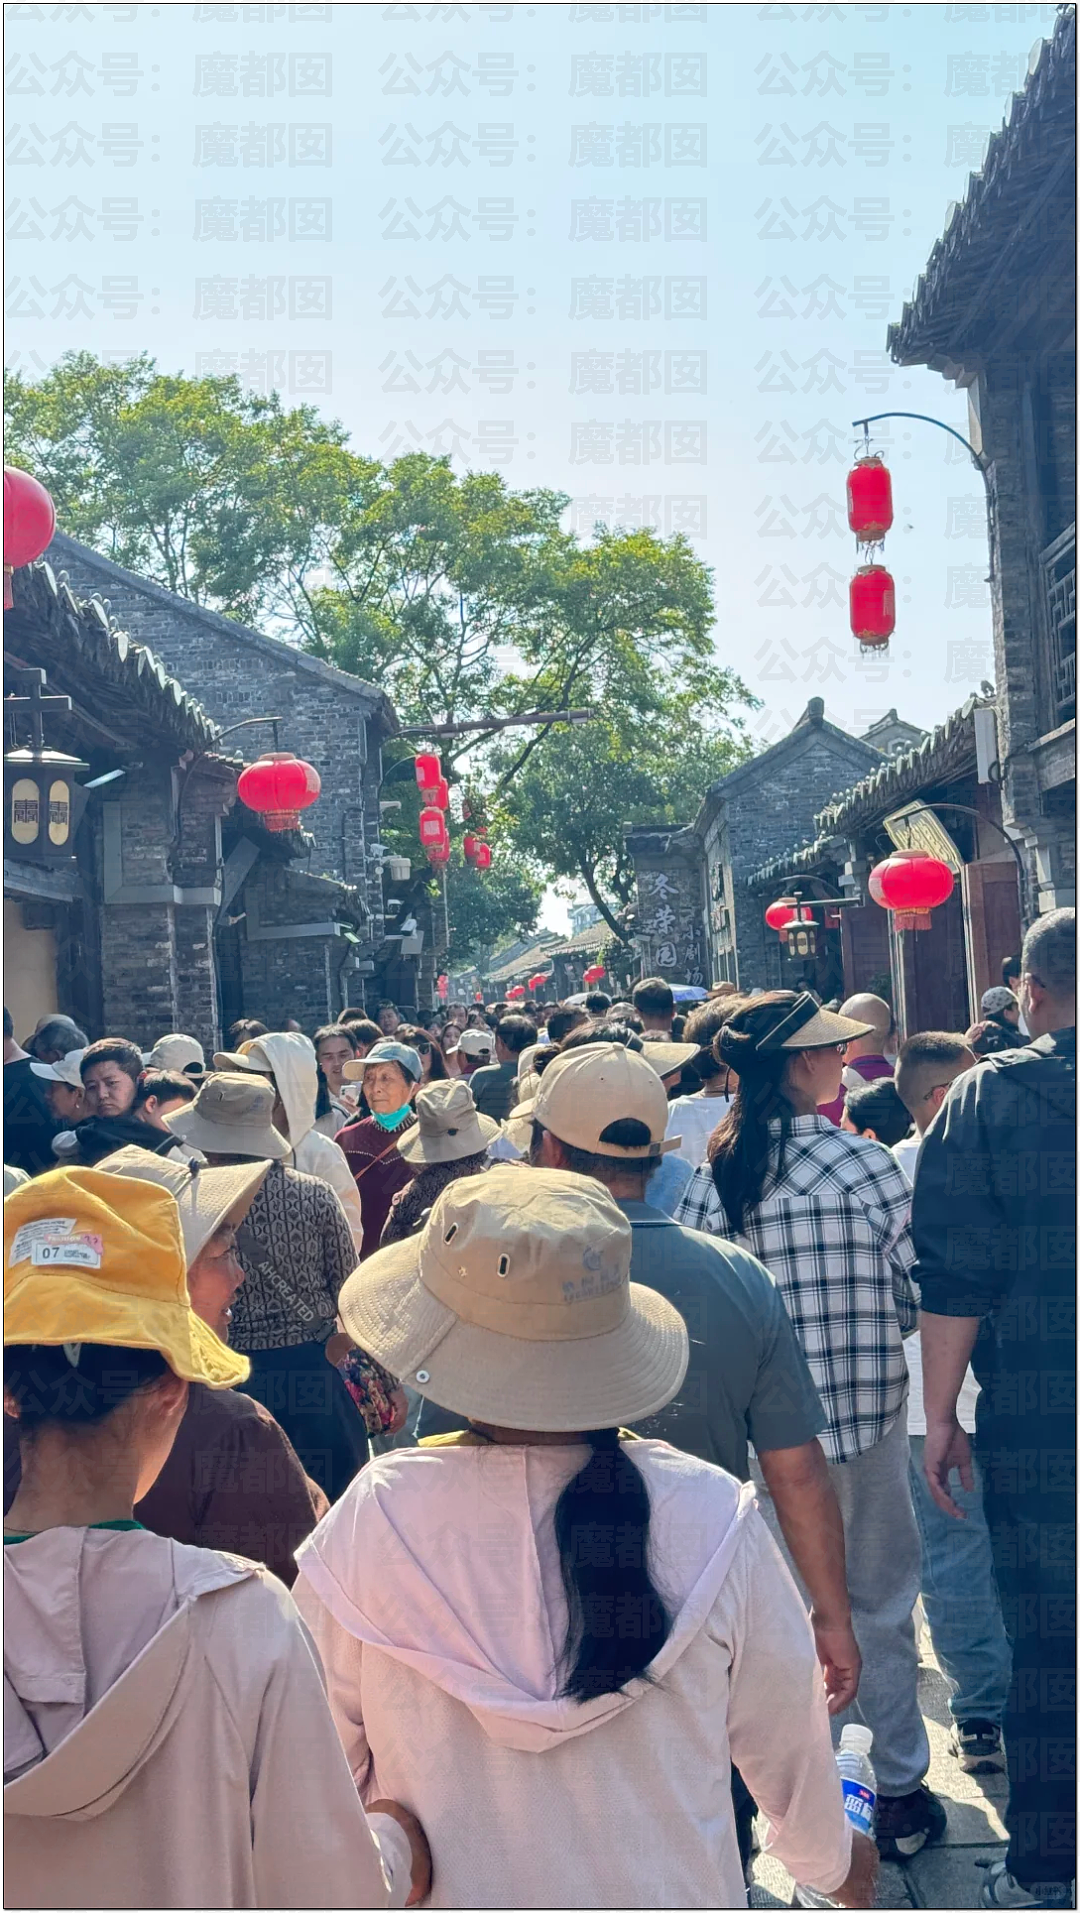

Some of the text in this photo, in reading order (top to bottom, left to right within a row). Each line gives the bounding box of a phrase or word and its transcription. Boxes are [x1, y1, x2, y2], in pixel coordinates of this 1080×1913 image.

[649, 873, 679, 967] 冬荣园
[681, 924, 704, 986] 小剧场
[42, 1247, 60, 1259] 07
[258, 1261, 314, 1322] AHCREATED
